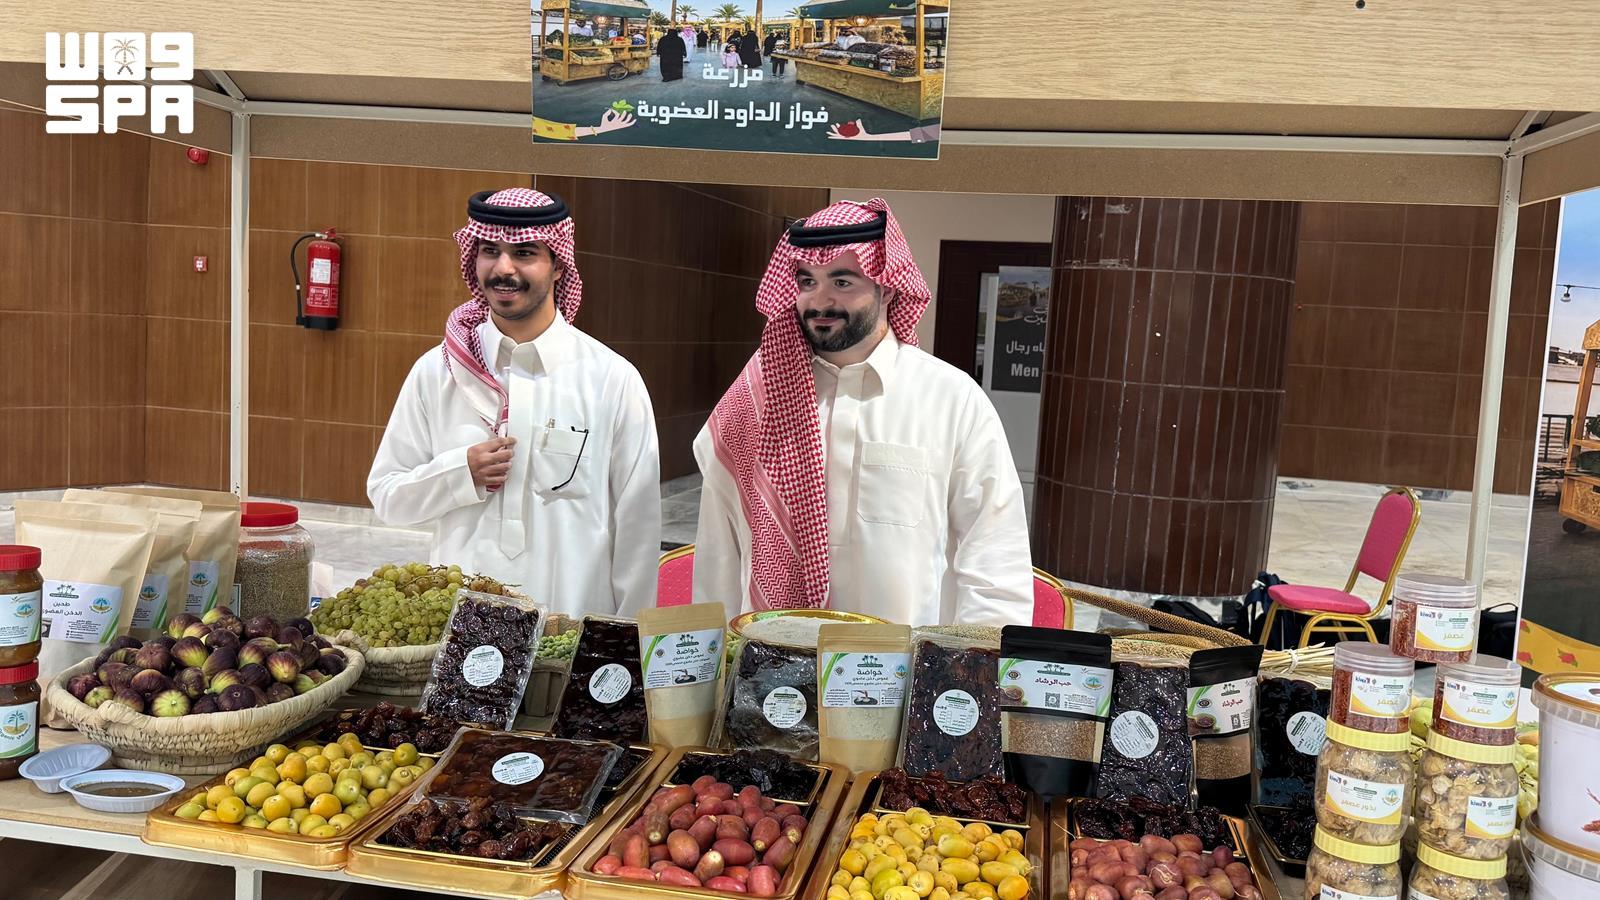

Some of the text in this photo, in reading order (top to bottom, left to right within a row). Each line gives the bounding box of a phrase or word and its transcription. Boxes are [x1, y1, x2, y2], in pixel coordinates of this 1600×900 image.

[702, 63, 764, 88] مزرعة
[637, 99, 829, 130] فواز الداود العضوية
[1006, 340, 1030, 355] رجال
[1010, 363, 1040, 377] Men
